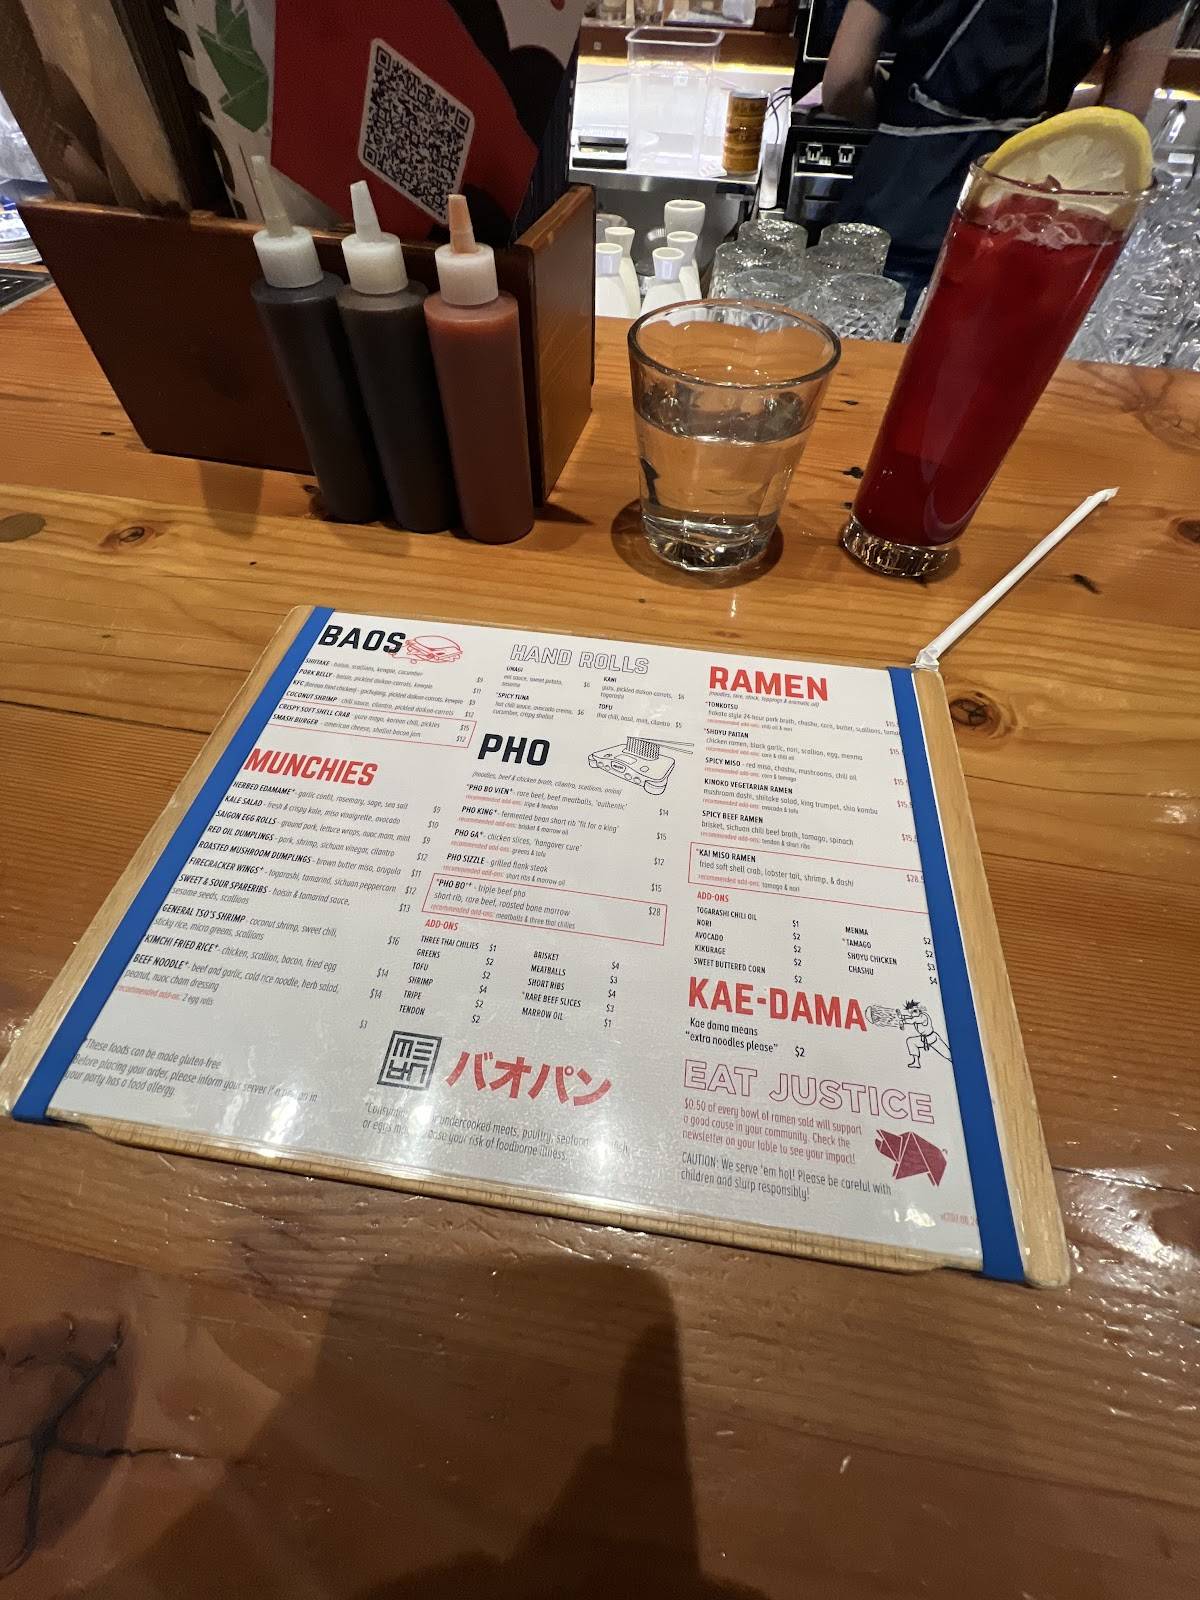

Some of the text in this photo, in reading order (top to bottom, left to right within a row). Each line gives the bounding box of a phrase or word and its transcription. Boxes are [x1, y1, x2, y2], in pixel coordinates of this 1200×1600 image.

[317, 624, 406, 654] BAOS
[509, 644, 573, 666] HAND
[578, 651, 649, 675] ROLLS
[709, 666, 828, 701] RAMEN
[272, 713, 319, 725] SMASH BURGER
[477, 733, 551, 766] PHO
[243, 748, 378, 786] MUNCHIES
[705, 756, 741, 767] SPICY MISO
[704, 777, 793, 794] KINOKO VEGETARIAN RAMEN
[224, 795, 263, 807] KALE SALAD
[461, 805, 476, 814] PHO
[659, 808, 669, 816] $14
[215, 809, 278, 825] SAIGON EGG ROLLS
[702, 809, 763, 823] SPICY BEEF RAMEN
[207, 825, 275, 841] RED OIL DUMPLINGS
[454, 828, 469, 837] PHO
[197, 840, 311, 864] ROASTED MUSHROOM DUMPLINGS
[416, 852, 428, 861] $12
[446, 852, 485, 864] PHO SIZZLE
[712, 850, 756, 863] MISO RAMEN
[188, 856, 236, 871] FIRECRACKER
[178, 873, 269, 894] SWEET & SOUR SPARERIBS
[651, 882, 662, 893] $15
[404, 885, 417, 895] $12
[697, 891, 729, 903] ADD-ONS
[162, 903, 194, 916] GENERAL
[215, 911, 246, 923] SHRIMP
[398, 903, 411, 913] $13
[648, 906, 661, 916] $28
[696, 906, 757, 921] TOGARASHI CHILI OIL
[424, 919, 459, 931] ADD-ONS
[696, 919, 712, 927] NORI
[792, 919, 799, 928] $1
[694, 931, 724, 942] AVOCADO
[792, 932, 801, 941] $2
[845, 926, 869, 936] MENMA
[172, 938, 196, 950] FRIED
[387, 935, 401, 946] $16
[416, 948, 440, 959] GREENS
[694, 944, 726, 955] KIKURAGE
[793, 944, 802, 953] $2
[132, 953, 154, 964] BEEF
[485, 957, 494, 966] $2
[533, 950, 559, 961] BRISKET
[847, 951, 898, 965] SHOYU CHICKEN
[412, 961, 429, 971] TOFU
[611, 961, 620, 970] $4
[693, 957, 766, 974] SWEET BUTTERED CORN
[793, 957, 802, 967] $2
[927, 962, 936, 971] $3
[376, 967, 390, 978] $14
[481, 970, 491, 980] $2
[530, 964, 566, 976] MEATBALLS
[848, 965, 874, 976] CHASHU
[407, 975, 434, 985] SHRIMP
[527, 978, 565, 991] SHORT RIBS
[609, 975, 618, 984] $3
[794, 974, 803, 984] $2
[929, 976, 938, 985] $4
[369, 987, 383, 999] $14
[403, 989, 421, 1000] TRIPE
[479, 984, 488, 994] $4
[607, 988, 616, 998] $4
[474, 998, 484, 1008] $2
[542, 994, 582, 1008] BEEF SLICES
[688, 976, 868, 1032] KAE-DAMA
[399, 1004, 426, 1015] TENDON
[521, 1007, 563, 1021] MARROW OIL
[471, 1014, 481, 1024] $2
[690, 1017, 758, 1036] Kae dama means
[712, 1037, 745, 1049] noodles
[794, 1045, 805, 1058] $2
[445, 1051, 612, 1107] バオパン
[683, 1058, 758, 1097] EAT
[768, 1072, 935, 1125] JUSTICE
[684, 1097, 862, 1136] $0.50 of every bowl of ramen sold will support
[683, 1115, 689, 1124] a
[690, 1116, 710, 1128] good
[711, 1119, 734, 1131] cause
[735, 1123, 743, 1132] in
[745, 1124, 763, 1136] your
[812, 1132, 836, 1146] Check
[837, 1136, 851, 1149] the
[682, 1129, 723, 1144] newsletter
[725, 1136, 736, 1146] on
[736, 1138, 755, 1151] your
[757, 1139, 778, 1153] table
[779, 1143, 788, 1154] to
[789, 1146, 804, 1157] see
[805, 1149, 824, 1161] your
[680, 1167, 715, 1184] children
[716, 1175, 733, 1187] and
[734, 1176, 756, 1193] slurp
[721, 1158, 734, 1171] We
[735, 1162, 758, 1175] serve
[797, 1169, 826, 1186] Please
[827, 1174, 839, 1187] be
[840, 1179, 871, 1193] careful
[872, 1183, 892, 1196] with
